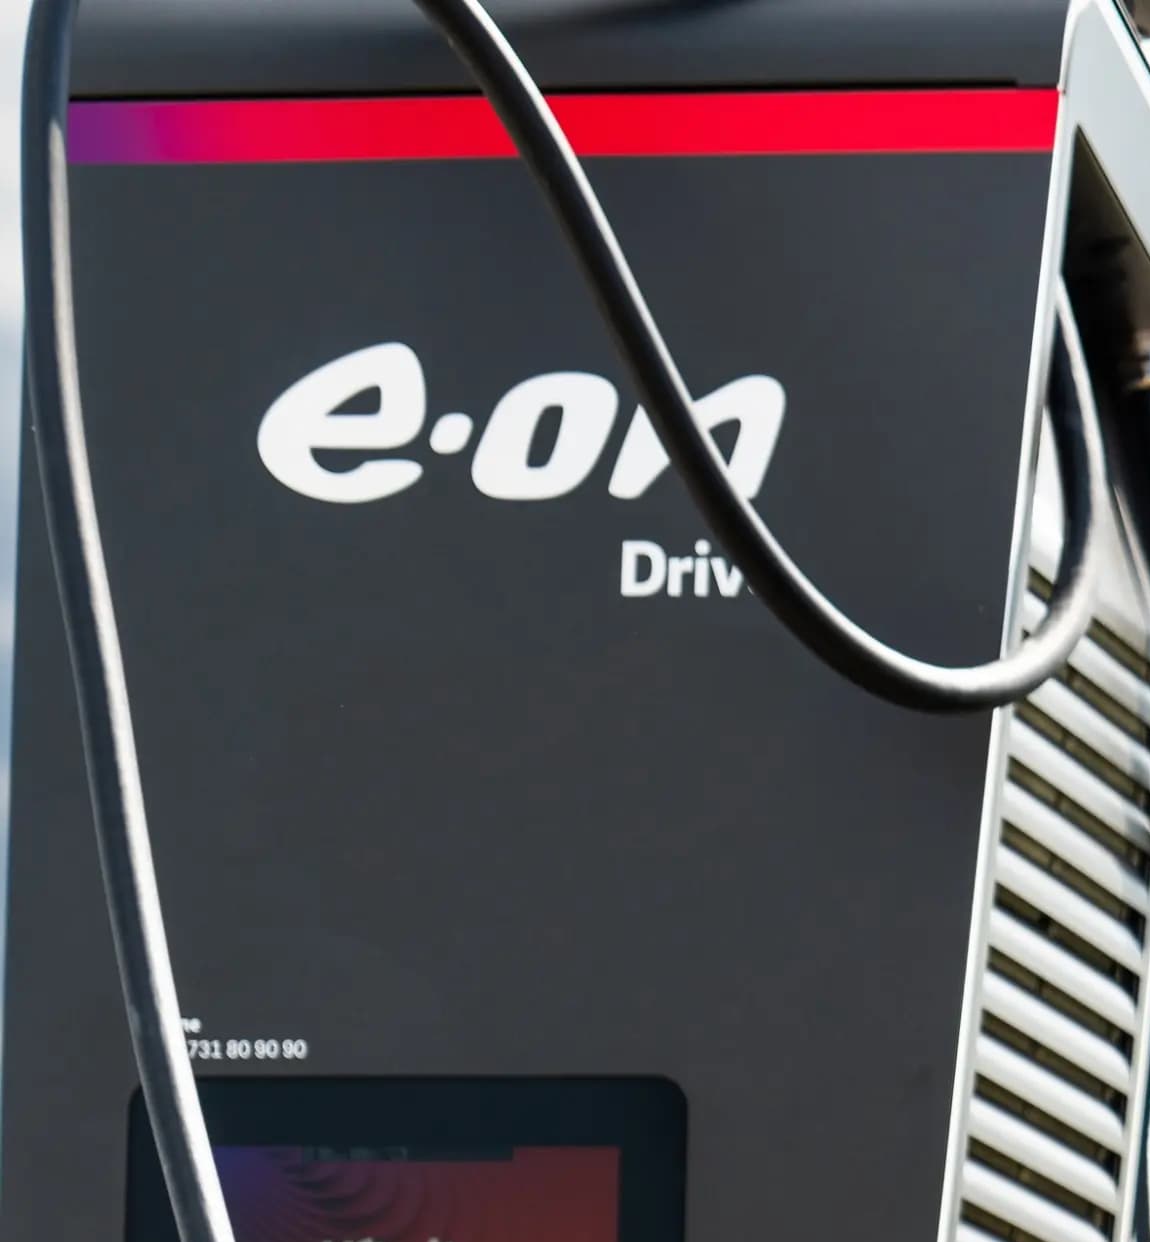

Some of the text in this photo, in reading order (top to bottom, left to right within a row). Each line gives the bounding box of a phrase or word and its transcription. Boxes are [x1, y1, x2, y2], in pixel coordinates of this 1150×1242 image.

[620, 539, 755, 598] Driv
[187, 1039, 308, 1060] 731 80 90 90
